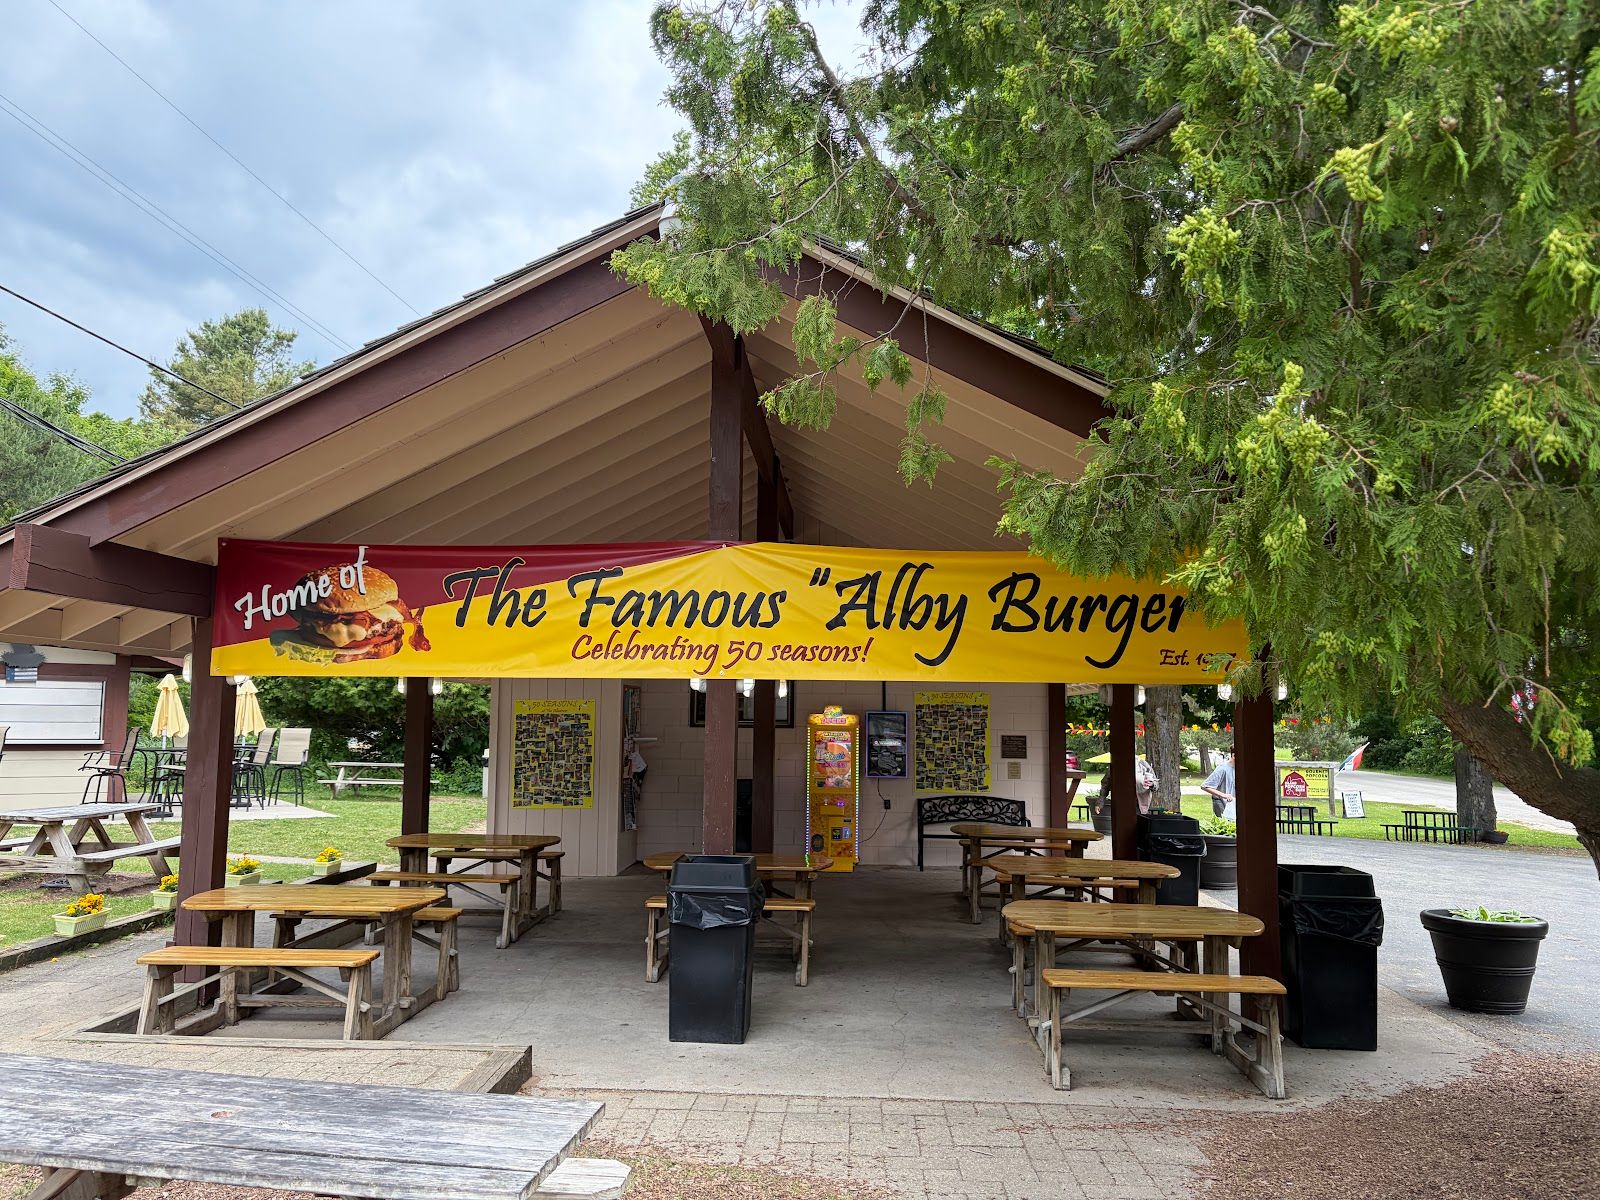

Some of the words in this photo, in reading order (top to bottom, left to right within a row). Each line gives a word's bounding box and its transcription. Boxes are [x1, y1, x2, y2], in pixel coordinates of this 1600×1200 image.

[234, 572, 332, 630] Home
[339, 545, 369, 594] of
[443, 556, 547, 629] The
[566, 566, 787, 629] Famous
[808, 561, 968, 668] "Alby
[570, 629, 720, 676] Celebrating
[722, 640, 764, 670] 50
[766, 636, 874, 663] seasons!
[1159, 648, 1190, 666] Est.
[541, 700, 577, 708] SEASONS
